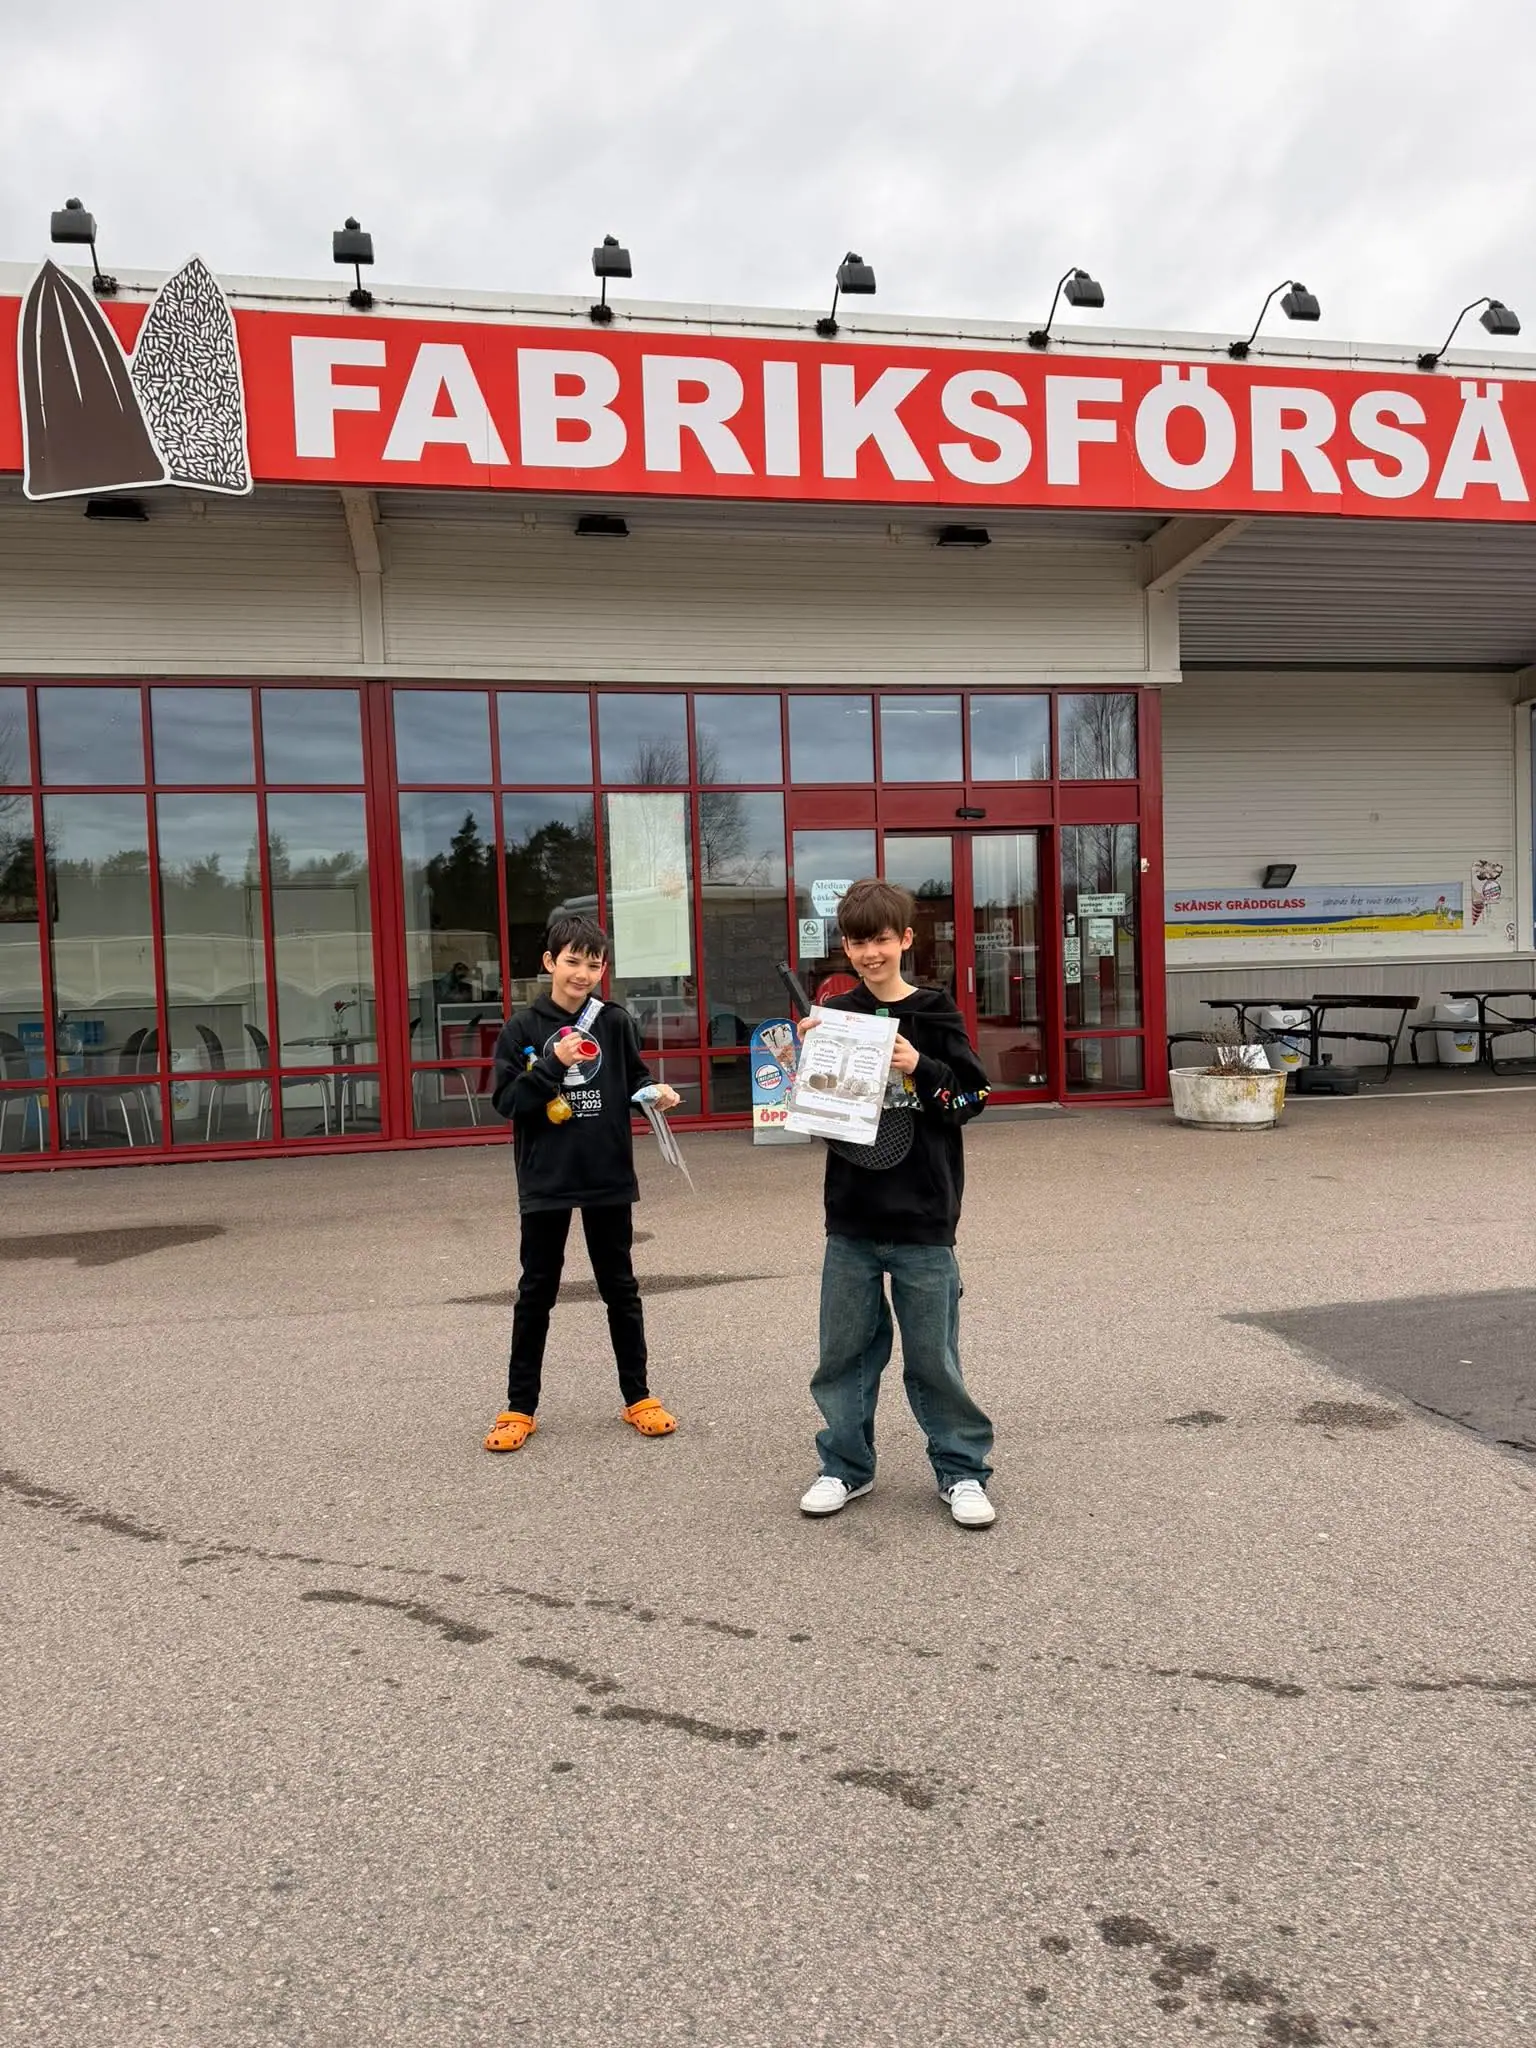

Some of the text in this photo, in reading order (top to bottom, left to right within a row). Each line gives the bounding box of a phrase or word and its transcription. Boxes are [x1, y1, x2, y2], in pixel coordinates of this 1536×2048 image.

[290, 334, 1530, 503] FABRIKSFÖRSÄ
[1226, 897, 1306, 910] GRÄDDGLASS
[760, 1108, 788, 1122] ÖPP
